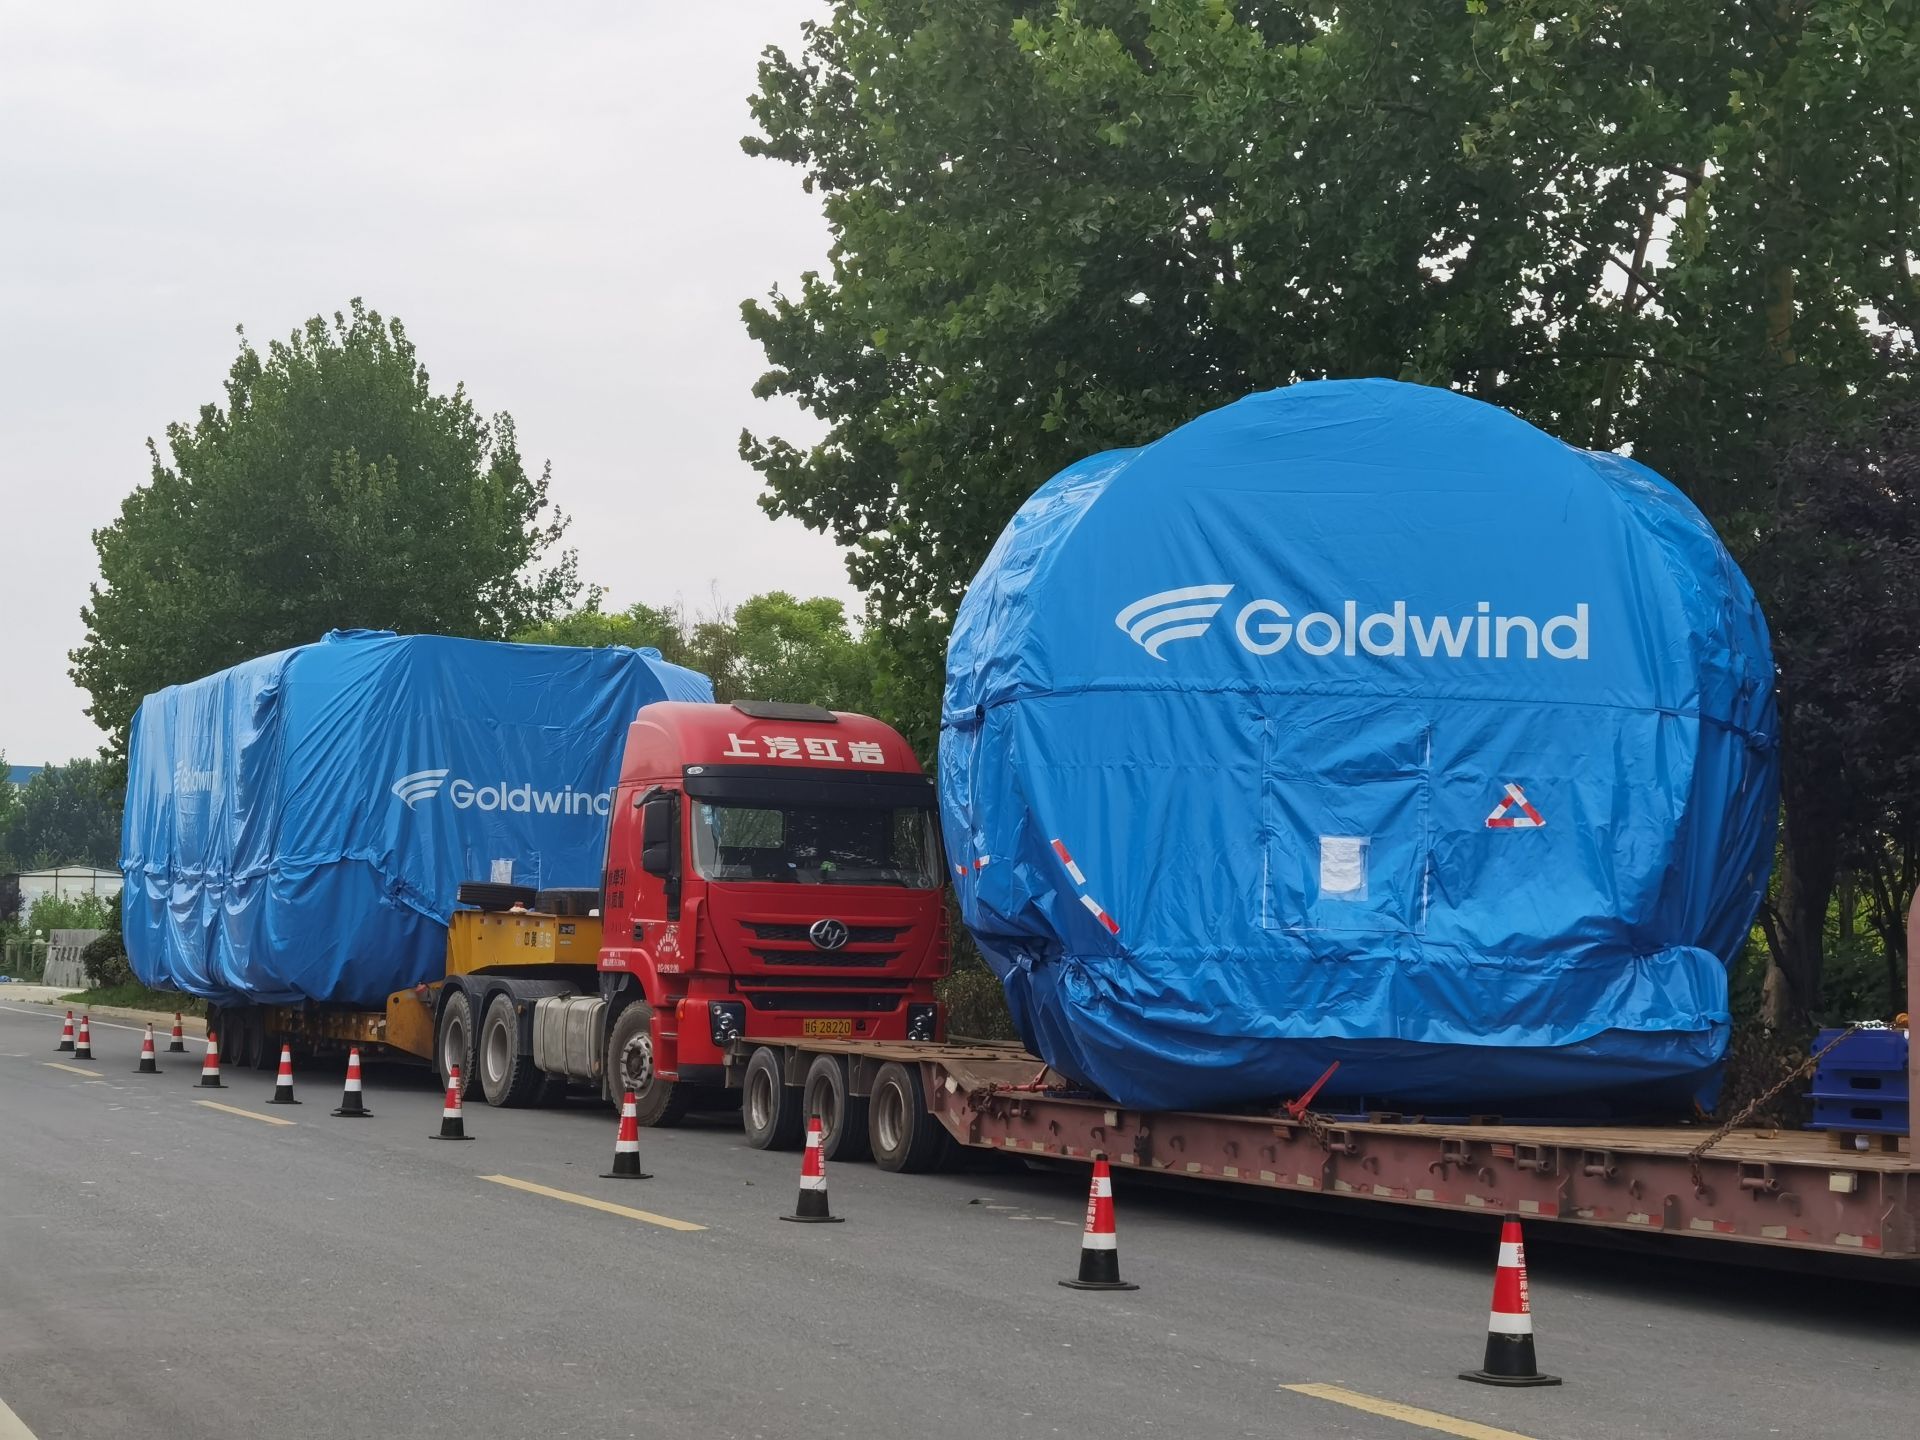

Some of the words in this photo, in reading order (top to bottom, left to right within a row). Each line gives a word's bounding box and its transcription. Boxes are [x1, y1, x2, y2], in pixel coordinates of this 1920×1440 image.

[1235, 599, 1589, 660] Goldwind
[723, 733, 885, 764] 上汽红岩
